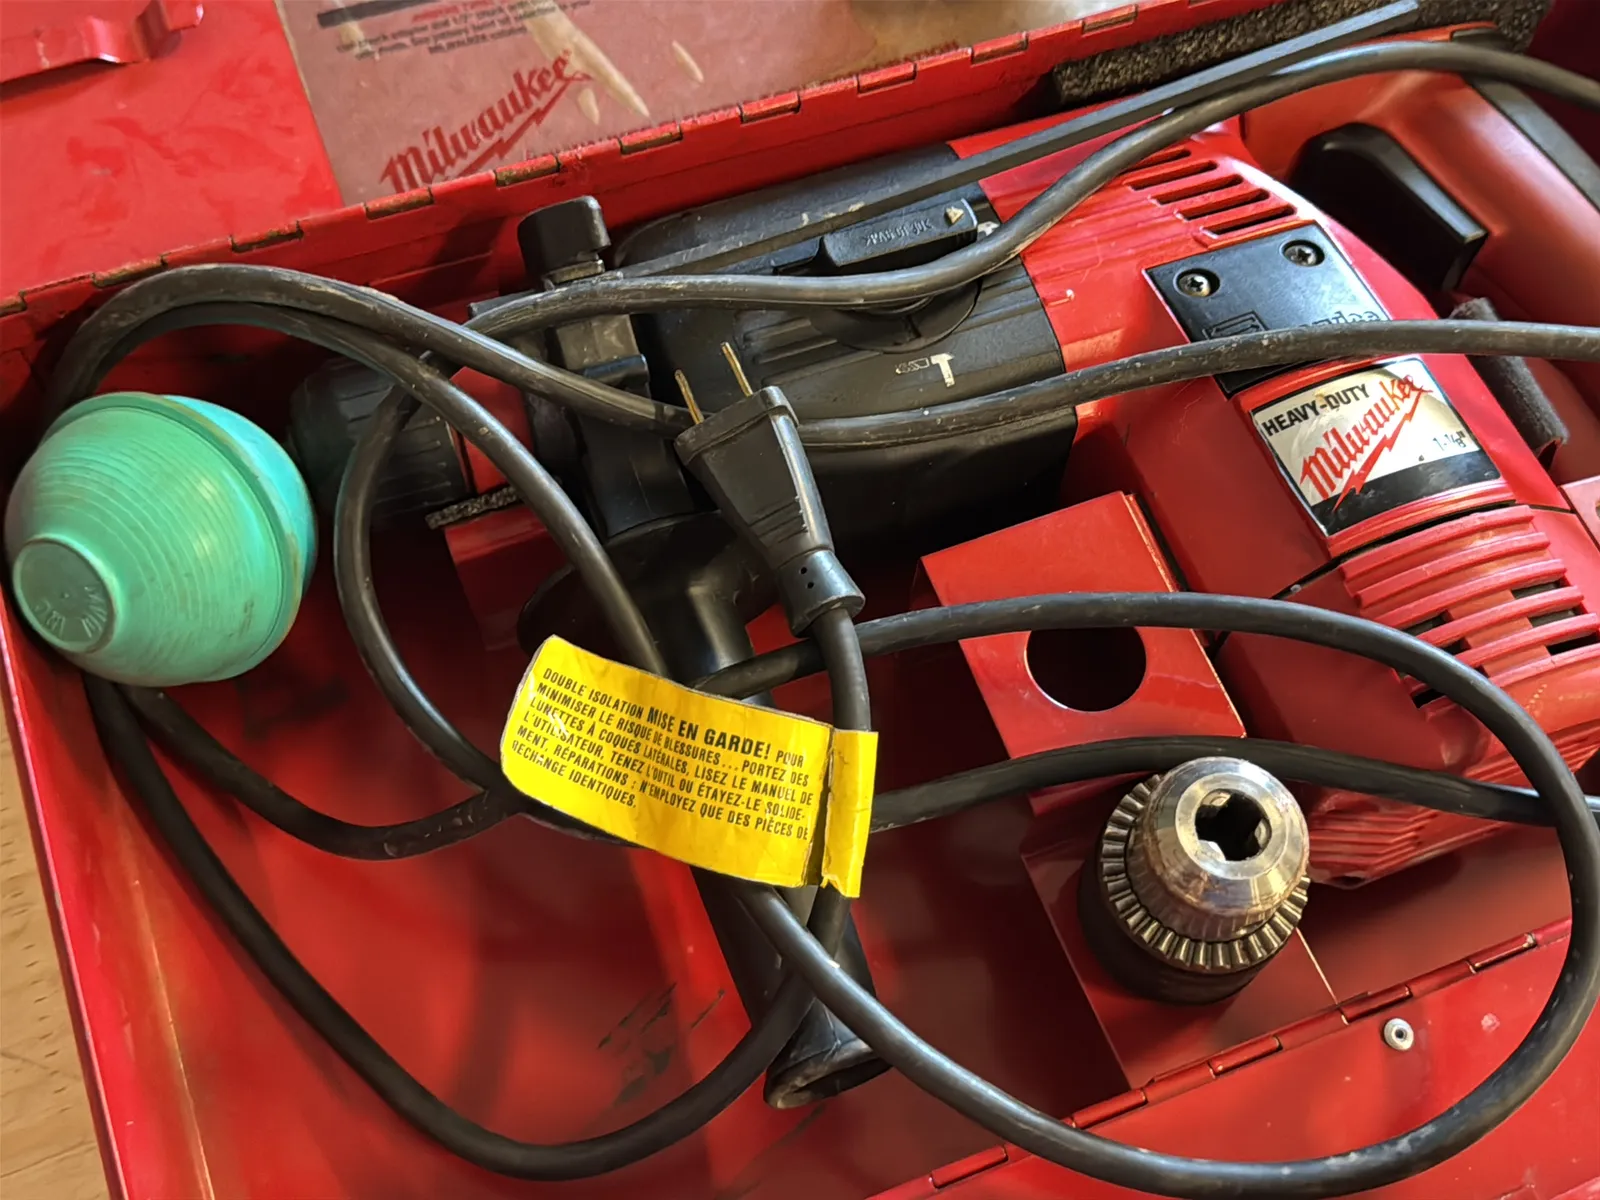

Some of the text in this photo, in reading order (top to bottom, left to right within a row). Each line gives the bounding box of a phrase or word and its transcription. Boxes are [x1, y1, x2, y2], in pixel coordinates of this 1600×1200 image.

[379, 49, 593, 193] Milwaukee
[1261, 383, 1371, 437] HEAVY-DUTY
[1300, 374, 1434, 500] Milwaukee
[511, 739, 567, 777] RECHANGE
[530, 697, 585, 732] LUNETTES
[598, 729, 642, 754] COQUES
[694, 768, 729, 787] LISEZ
[731, 777, 748, 790] LE
[751, 780, 796, 802] MANUEL
[800, 792, 813, 806] DE
[537, 682, 598, 718] MINIMISER
[599, 710, 614, 726] LE
[616, 718, 652, 741] RISQUE
[652, 731, 664, 746] DE
[741, 760, 789, 782] PORTEZ
[790, 771, 809, 787] DES
[543, 668, 804, 768] DOUBLE ISOLATION MISE EN GARDE! POUR
[553, 743, 629, 786] RÉPARATIONS
[639, 779, 697, 813] N'EMPLOYEZ
[699, 802, 724, 821] QUE
[727, 810, 751, 828] DES
[754, 815, 793, 837] PIÈCES
[796, 826, 809, 841] DE
[610, 750, 645, 774] TENEZ
[646, 764, 676, 787] L'OUTIL
[679, 780, 694, 794] OU
[697, 780, 762, 812] ÉTAYEZ-LE
